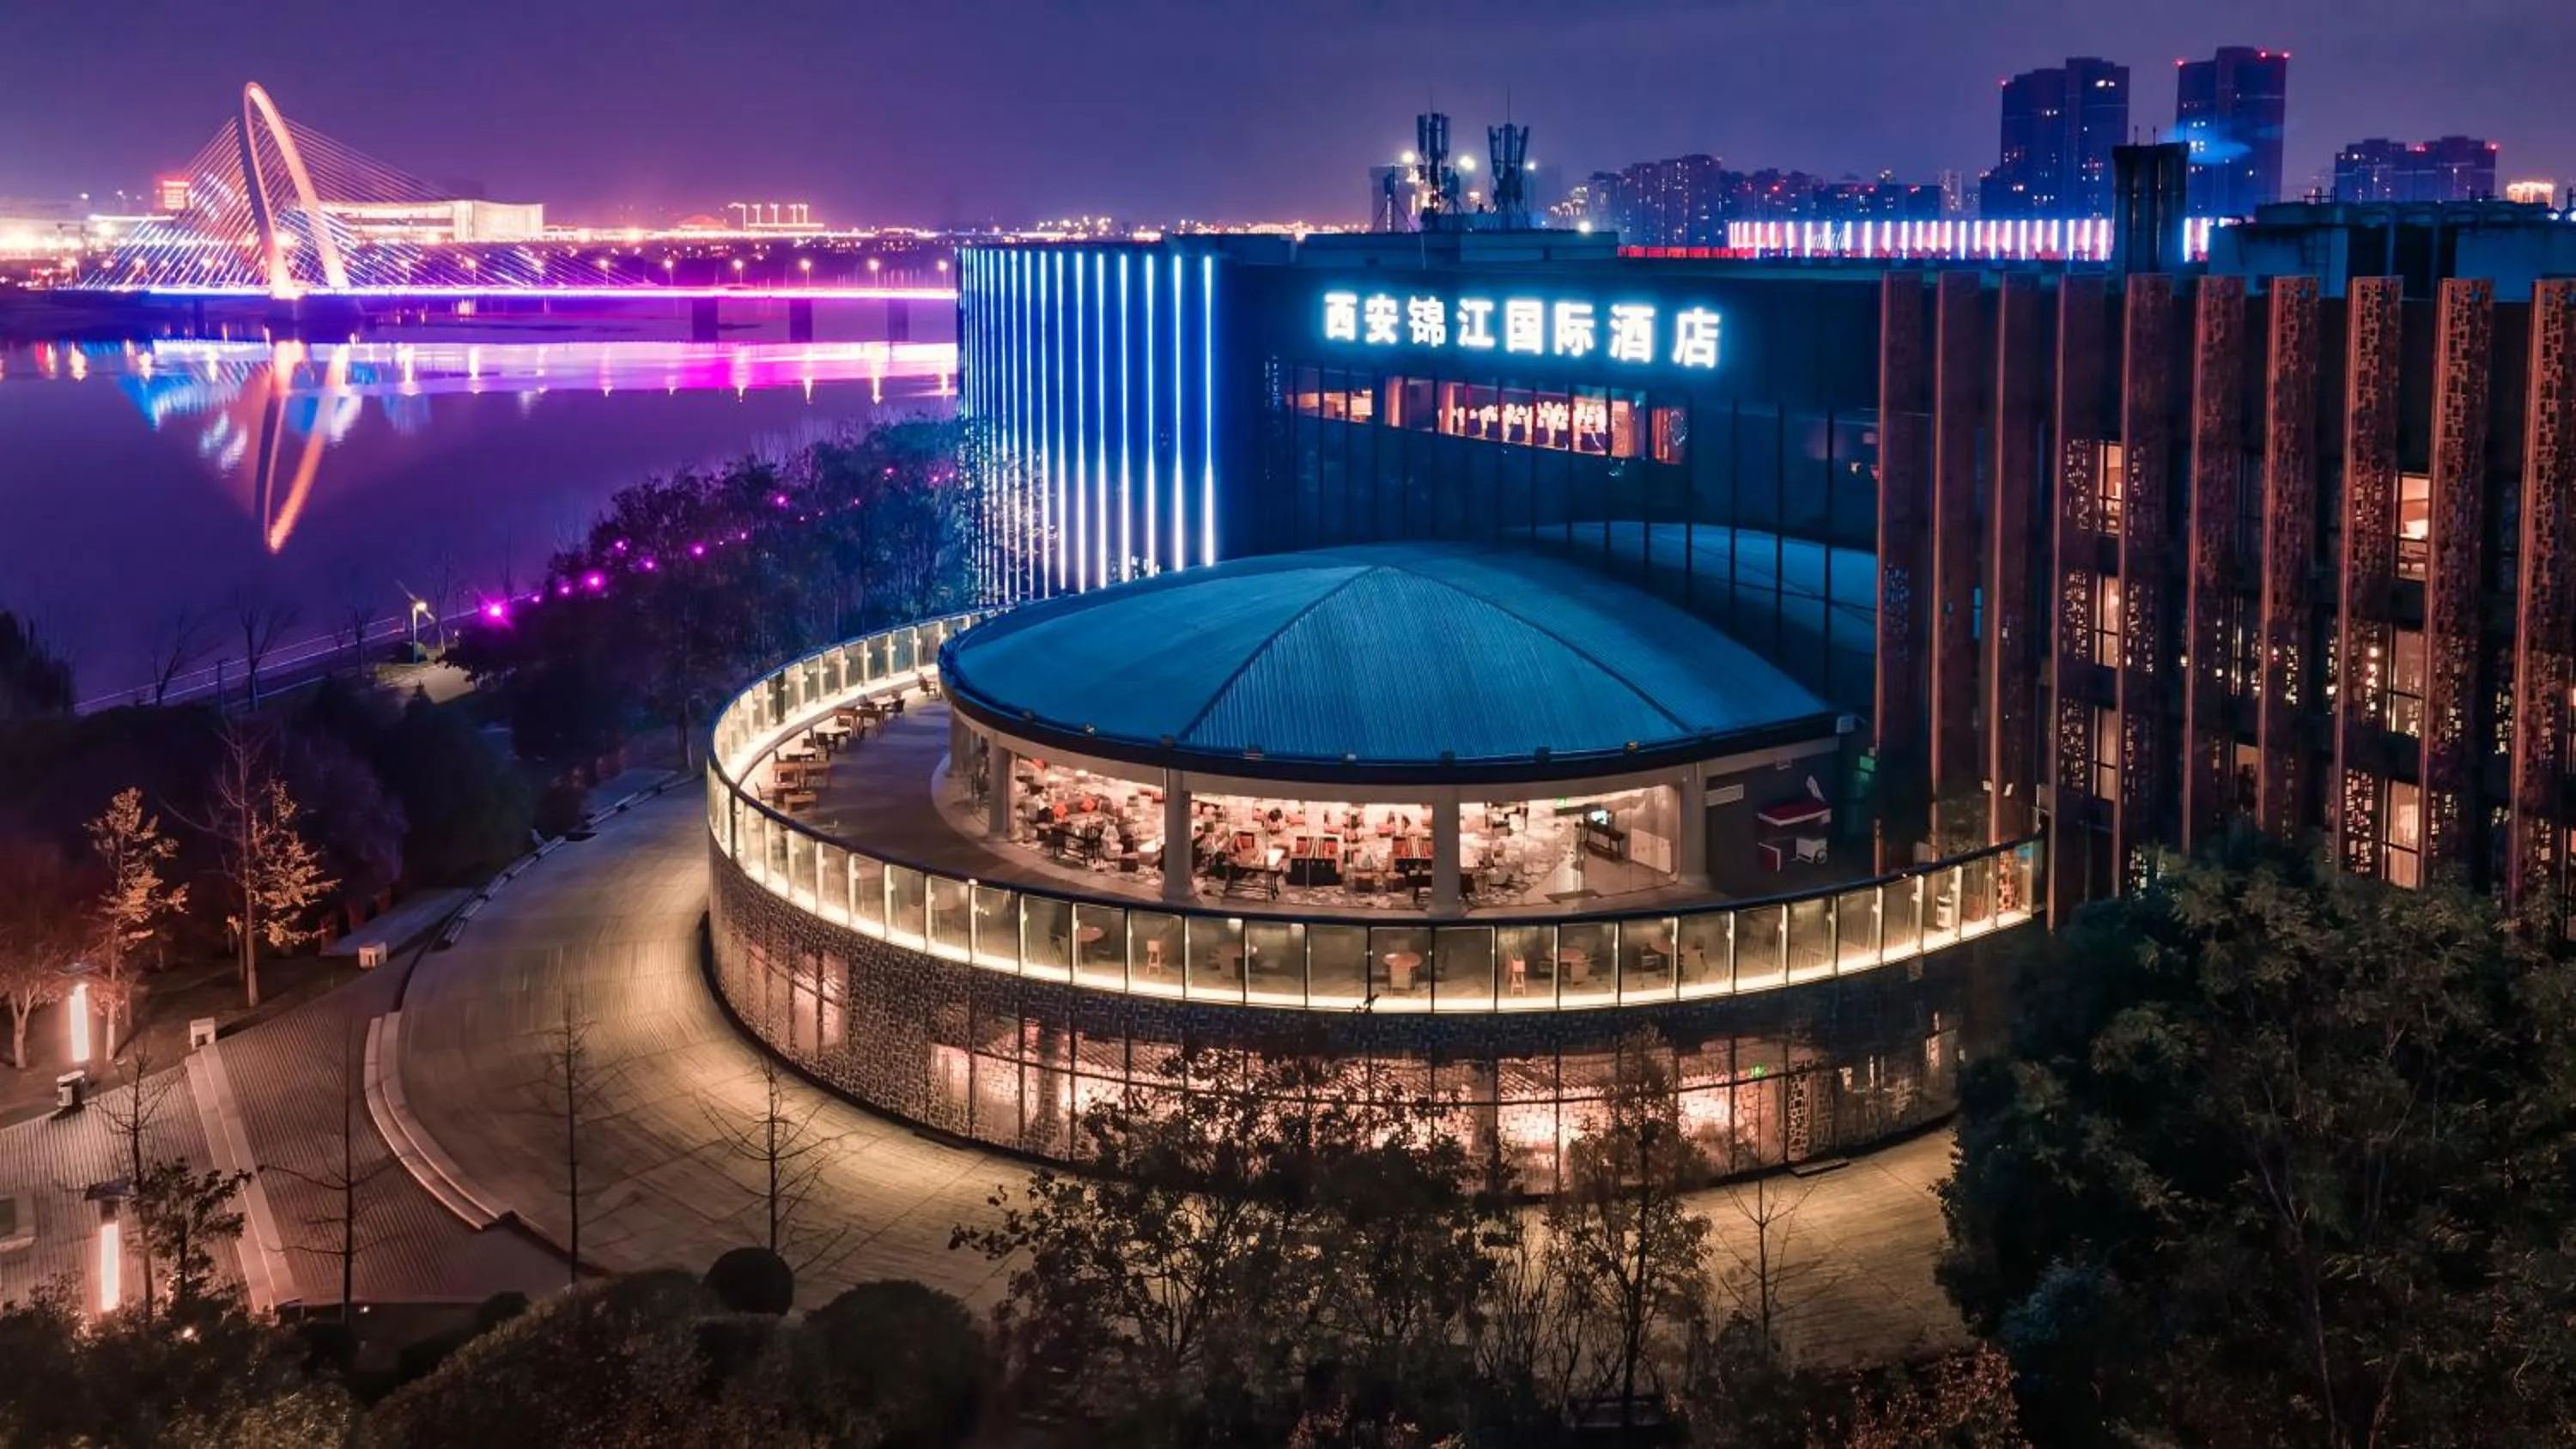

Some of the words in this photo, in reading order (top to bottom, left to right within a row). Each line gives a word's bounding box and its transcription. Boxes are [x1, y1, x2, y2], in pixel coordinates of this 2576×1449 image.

[1324, 292, 1721, 368] 西安锦江国际酒店
